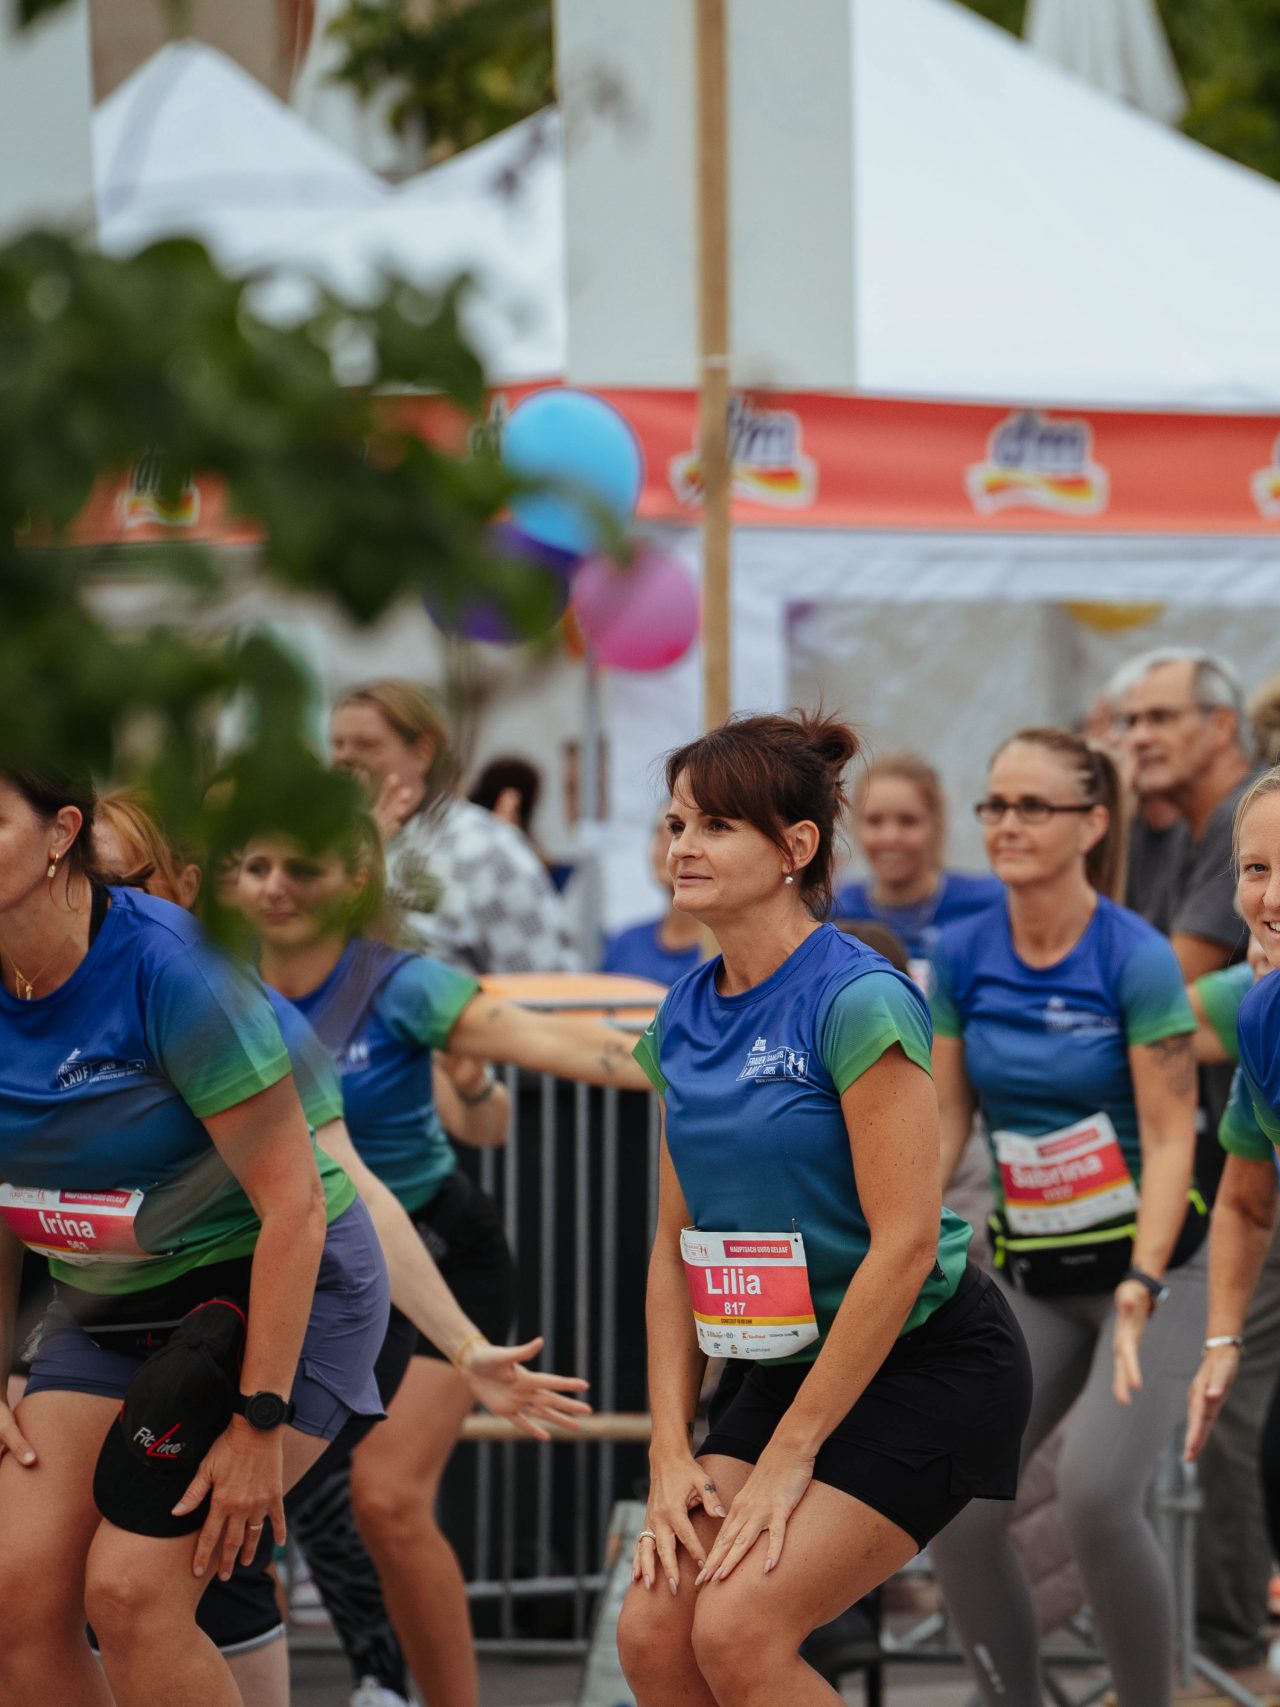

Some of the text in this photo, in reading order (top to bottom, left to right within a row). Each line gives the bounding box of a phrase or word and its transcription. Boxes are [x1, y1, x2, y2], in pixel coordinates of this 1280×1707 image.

[993, 409, 1087, 474] dm
[60, 1065, 89, 1088] LAUF
[1009, 1155, 1105, 1190] Sabrina
[38, 1211, 97, 1239] Irina
[705, 1268, 761, 1295] Lilia
[724, 1302, 746, 1316] 817
[133, 1423, 182, 1458] FitLine
